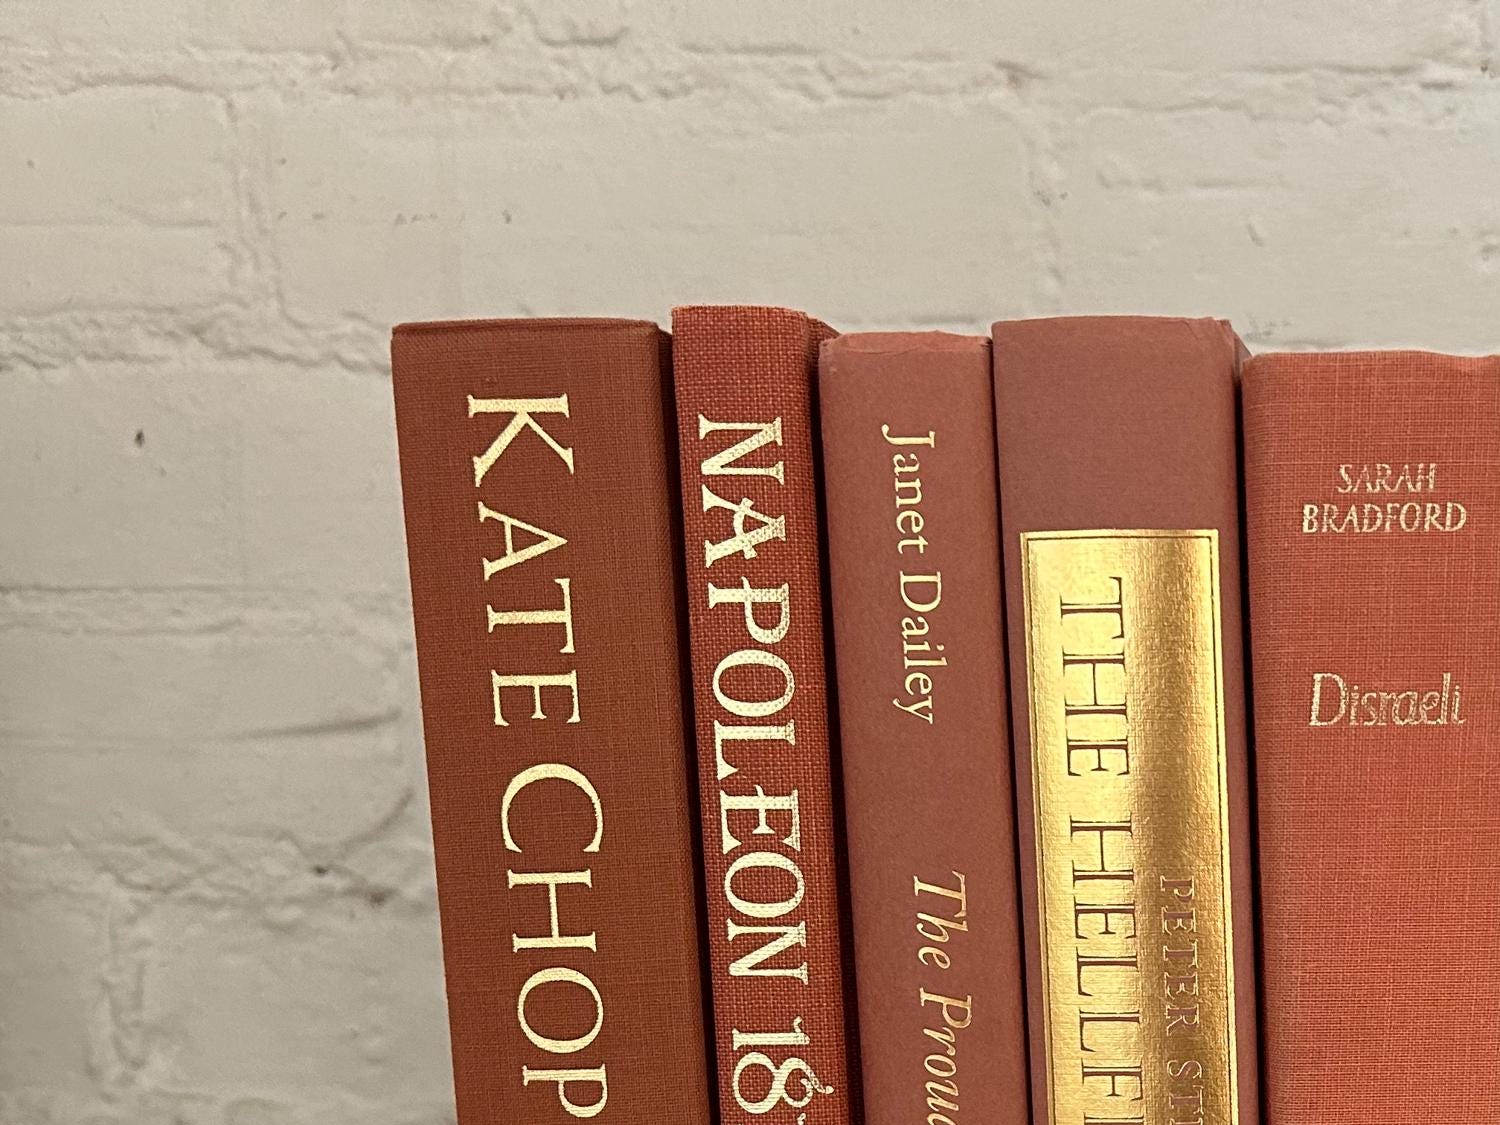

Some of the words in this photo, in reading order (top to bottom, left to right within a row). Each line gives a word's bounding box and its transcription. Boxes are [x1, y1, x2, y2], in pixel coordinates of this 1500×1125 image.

[882, 424, 936, 555] Janet
[1301, 502, 1468, 534] BRADFORD
[1336, 463, 1437, 494] SARAH
[467, 394, 582, 725] KATE
[698, 413, 809, 984] NAPOLEON
[892, 571, 948, 725] Dailey
[1059, 576, 1130, 777] THE
[1308, 671, 1467, 727] Disraeli
[912, 870, 969, 969] The
[1160, 874, 1201, 1037] PETER
